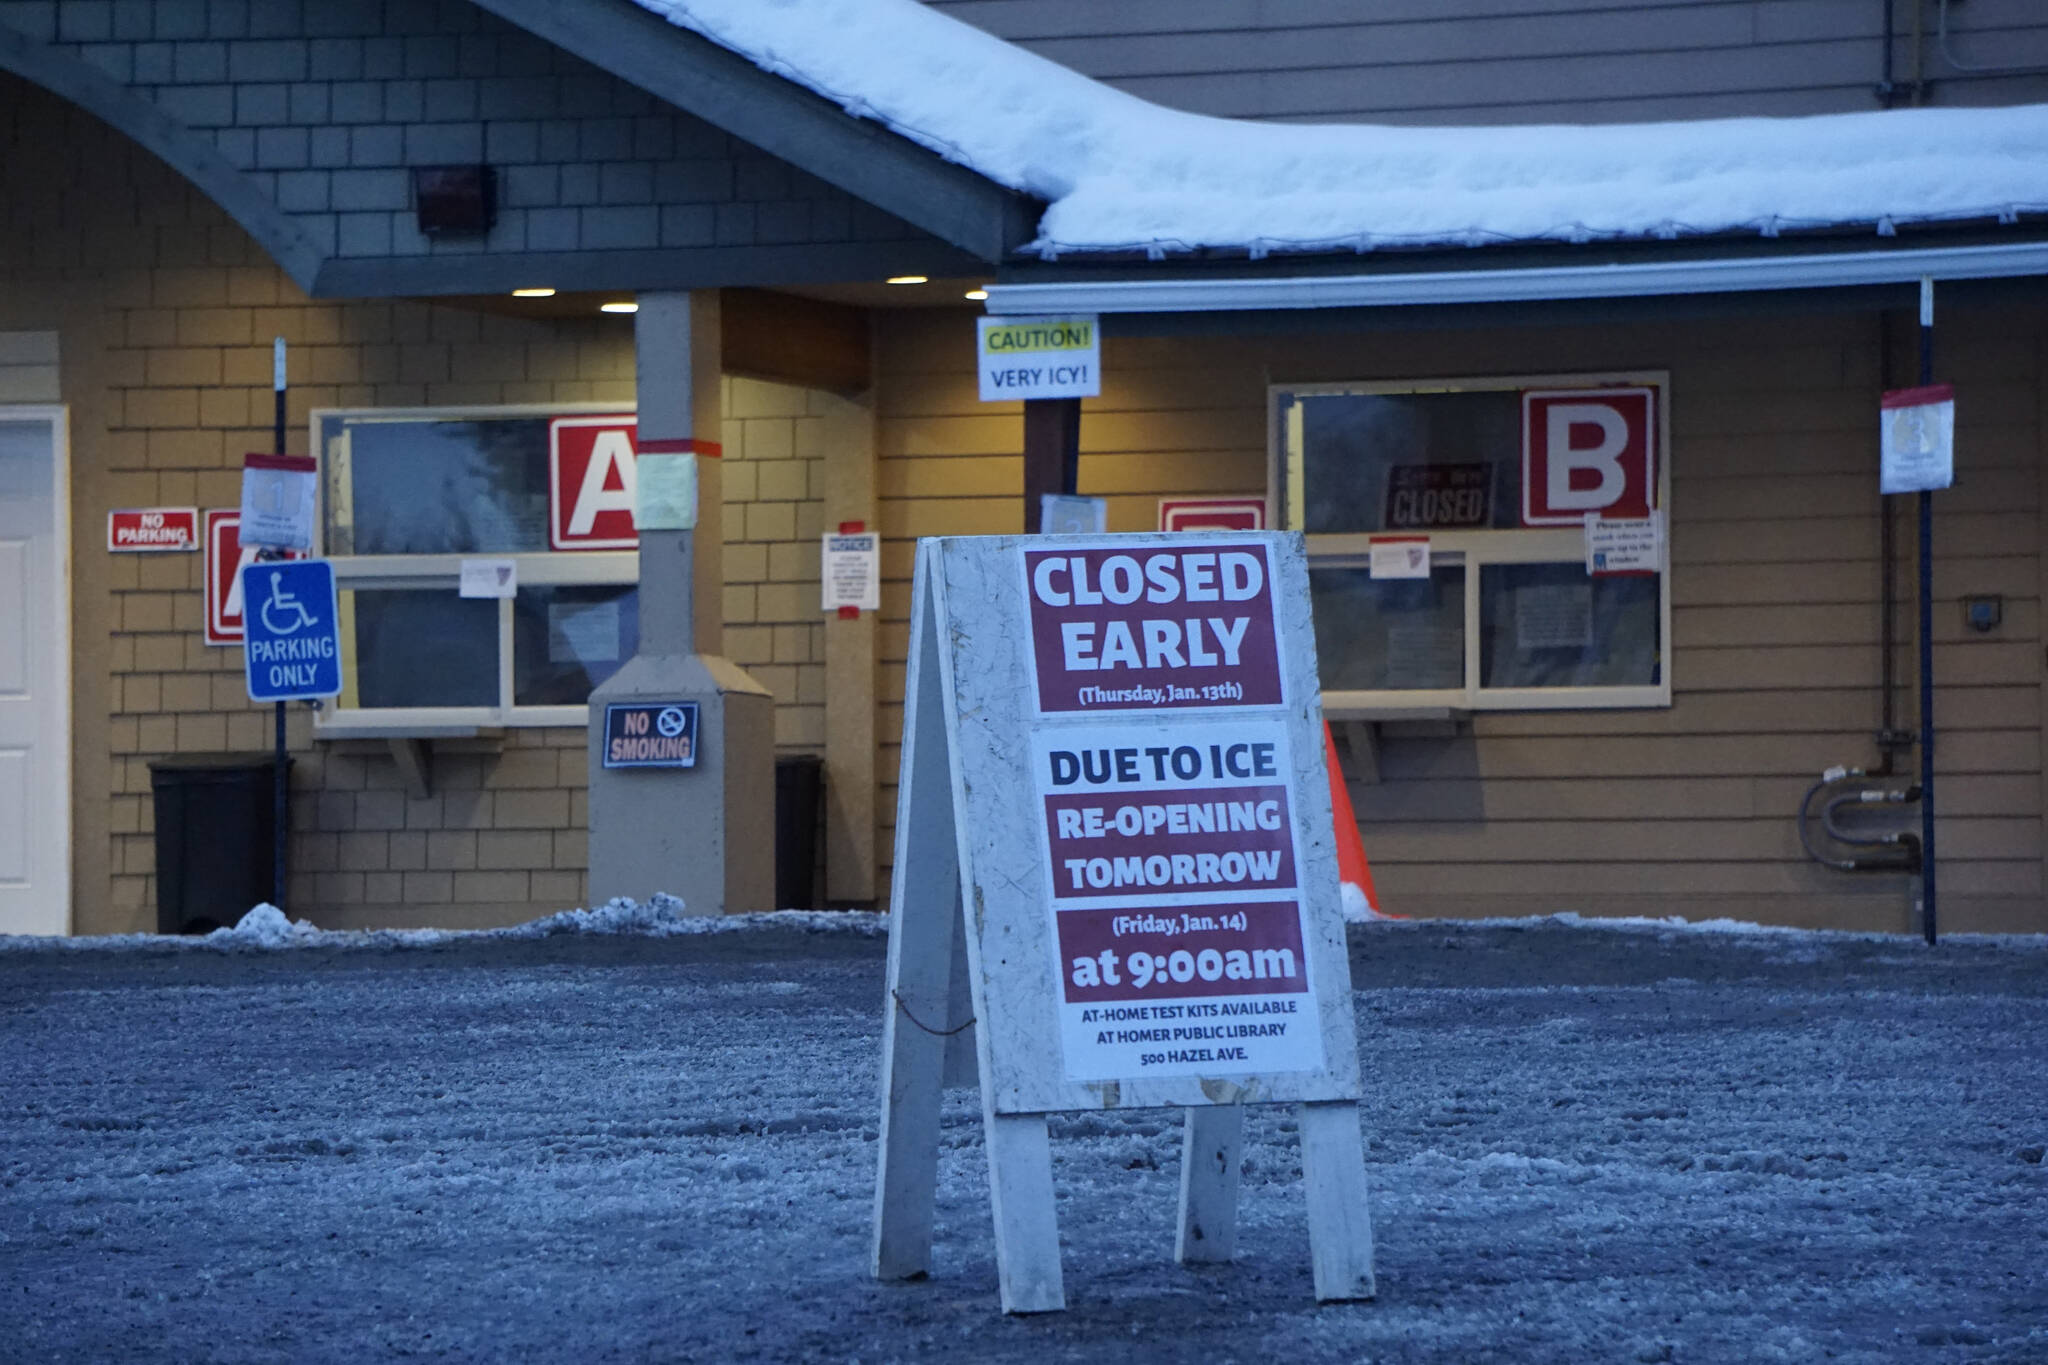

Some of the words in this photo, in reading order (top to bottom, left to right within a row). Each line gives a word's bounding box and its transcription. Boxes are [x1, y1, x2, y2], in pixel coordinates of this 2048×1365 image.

[988, 326, 1089, 350] CAUTION!
[990, 368, 1042, 388] VERY
[1049, 365, 1088, 385] ICY!
[1546, 403, 1629, 511] B
[567, 430, 638, 536] A
[1393, 488, 1484, 524] CLOSED
[141, 514, 165, 528] NO
[117, 527, 188, 543] PARKING
[1033, 552, 1263, 607] CLOSED
[251, 636, 334, 663] PARKING
[1061, 617, 1250, 671] EARLY
[269, 663, 317, 688] ONLY
[1078, 684, 1166, 705] (Thursday,
[1167, 683, 1200, 702] Jan.
[1202, 681, 1243, 702] 13th)
[624, 711, 650, 735] NO
[611, 736, 691, 761] SMOKING
[1049, 748, 1141, 786] DUE
[1145, 745, 1202, 782] TO
[1210, 743, 1277, 779] ICE
[1056, 800, 1282, 839] RE-OPENING
[1064, 850, 1282, 889] TOMORROW
[1112, 913, 1181, 937] (Friday,
[1181, 912, 1219, 934] Jan.
[1220, 911, 1247, 932] 14)
[1071, 949, 1121, 988] at
[1127, 948, 1296, 988] 9:00am
[1082, 1006, 1149, 1023] AT-HOME
[1150, 1005, 1184, 1020] TEST
[1187, 1004, 1218, 1018] KITS
[1220, 1001, 1297, 1016] AVAILABLE
[1097, 1031, 1114, 1045] AT
[1117, 1029, 1171, 1044] HOMER
[1173, 1025, 1225, 1041] PUBLIC
[1226, 1023, 1287, 1039] LIBRARY
[1141, 1053, 1165, 1067] 500
[1168, 1049, 1214, 1064] HAZEL
[1216, 1047, 1248, 1062] AVE.
